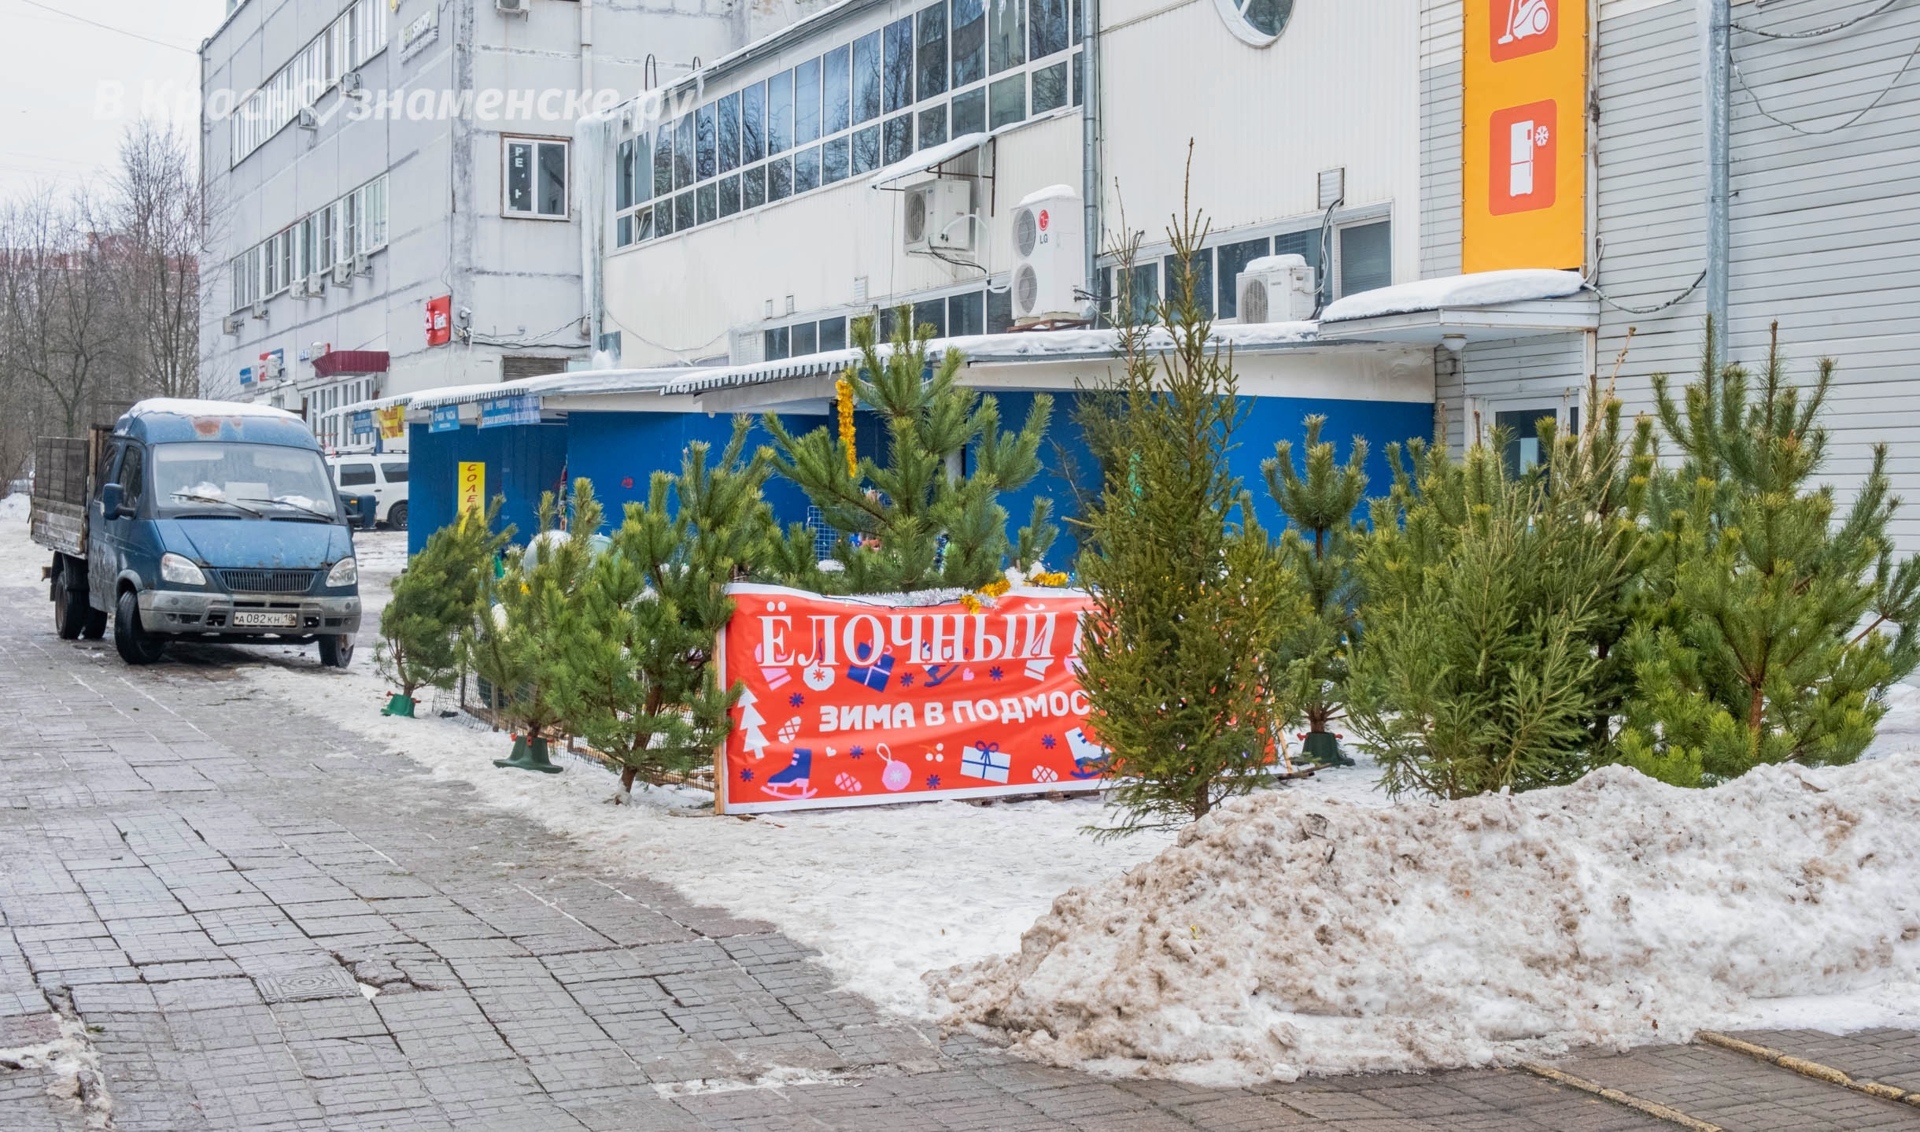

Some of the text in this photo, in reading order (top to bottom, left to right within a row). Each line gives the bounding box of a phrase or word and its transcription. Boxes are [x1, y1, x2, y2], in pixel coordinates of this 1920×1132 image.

[1040, 233, 1048, 245] LG
[756, 601, 1061, 667] ЁЛОЧНЫЙ
[819, 689, 1091, 733] ЗИМА В ПОДМОС
